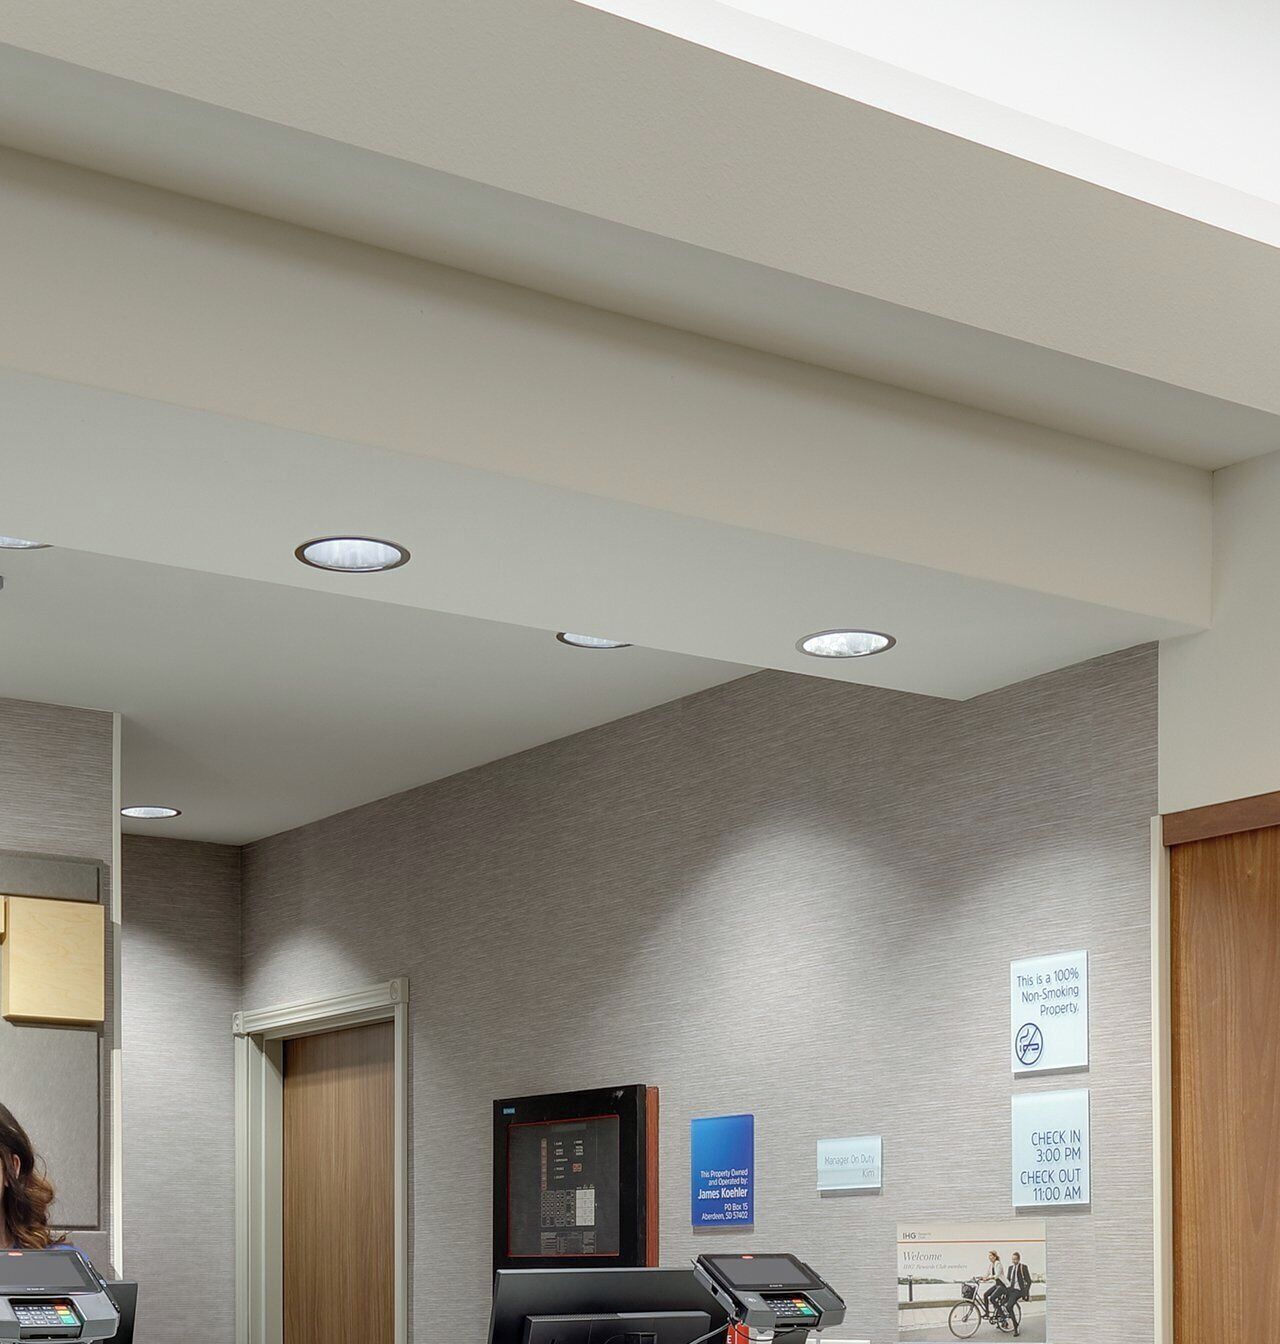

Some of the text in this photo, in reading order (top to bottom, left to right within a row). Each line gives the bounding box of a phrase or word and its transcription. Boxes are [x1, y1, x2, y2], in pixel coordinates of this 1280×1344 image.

[1017, 967, 1080, 988] This is a 100%
[1021, 985, 1079, 1003] Non-Smoking
[1040, 1001, 1080, 1017] Property.
[1031, 1129, 1081, 1146] CHECK IN
[850, 1154, 859, 1165] On
[1036, 1146, 1081, 1163] 3:00 PM
[700, 1170, 710, 1178] This
[710, 1169, 730, 1178] Property
[1020, 1168, 1081, 1185] CHECK OUT
[698, 1187, 748, 1199] James Koehler
[1033, 1185, 1081, 1201] 11:00 AM
[724, 1202, 749, 1211] PO Box 15
[902, 1232, 917, 1240] IHG
[902, 1251, 943, 1261] Welcome
